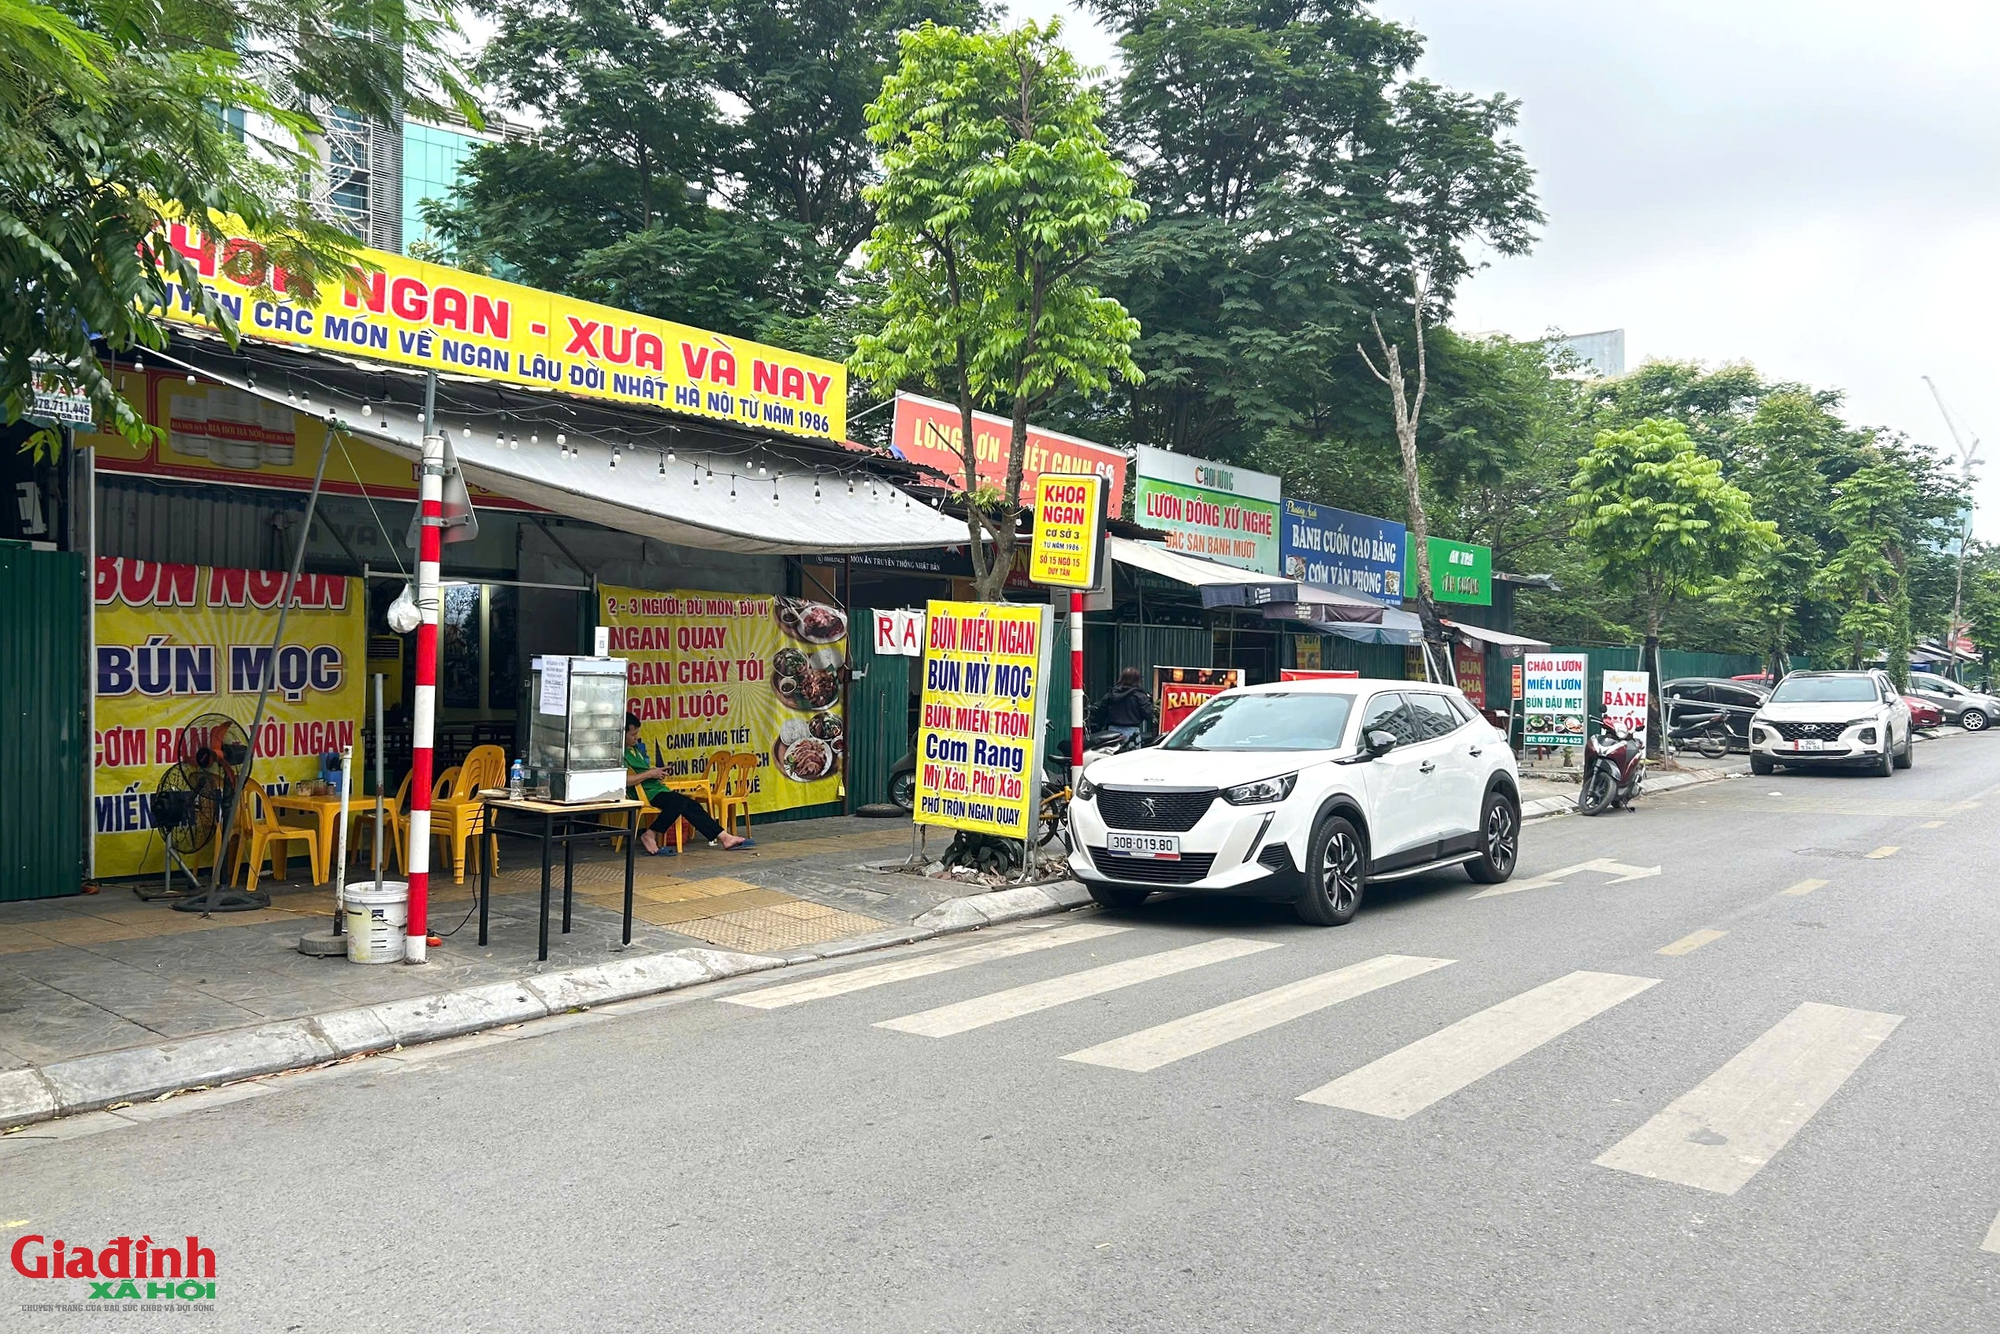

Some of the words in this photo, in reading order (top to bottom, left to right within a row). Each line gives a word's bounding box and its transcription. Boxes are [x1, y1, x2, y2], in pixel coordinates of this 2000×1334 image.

[344, 266, 509, 339] NGAN
[565, 317, 663, 371] XƯA
[681, 337, 735, 386] VÀ
[753, 360, 831, 405] NAY
[254, 299, 313, 335] CÁC
[324, 315, 388, 349] MÓN
[399, 328, 438, 358] VỀ
[442, 339, 509, 372] NGAN
[519, 354, 561, 382] LÂU
[569, 360, 605, 390] ĐỜI
[613, 373, 668, 401] NHẤT
[676, 381, 700, 408] HÀ
[708, 391, 734, 417] NỘI
[740, 394, 759, 419] TỪ
[763, 402, 794, 426] NĂM
[799, 411, 829, 433] 1986
[913, 416, 963, 452] LÒNG
[1044, 485, 1086, 504] KHOA
[1043, 506, 1085, 525] NGAN
[1147, 492, 1182, 520] LƯƠN
[1186, 494, 1220, 527] ĐỒNG
[1223, 504, 1241, 530] XỨ
[1243, 510, 1272, 540] NGHỆ
[1046, 529, 1058, 538] CƠ
[1060, 528, 1072, 539] SỞ
[1066, 543, 1080, 551] 1986
[1187, 528, 1205, 552] SẢN
[1207, 533, 1231, 556] BÁNH
[1323, 524, 1350, 555] CUỐN
[1352, 536, 1370, 560] CAO
[1372, 530, 1396, 563] BẰNG
[1049, 556, 1057, 565] 15
[1073, 559, 1080, 567] 15
[1352, 565, 1382, 594] PHÒNG
[607, 598, 617, 615] 2
[630, 598, 639, 615] 3
[609, 626, 670, 650] NGAN
[677, 626, 727, 652] QUAY
[930, 609, 958, 650] BÚN
[960, 608, 995, 652] MIẾN
[997, 620, 1036, 655] NGAN
[95, 634, 217, 697] BÚN
[227, 644, 345, 702] MỌC
[627, 661, 671, 686] GAN
[677, 656, 731, 684] CHÁY
[736, 652, 765, 682] TỎI
[927, 653, 961, 692] BÚN
[965, 656, 991, 695] MỲ
[994, 664, 1032, 704] MỌC
[1460, 659, 1481, 675] BÚN
[1527, 659, 1553, 672] CHÁO
[1556, 660, 1582, 672] LƯƠN
[1460, 677, 1482, 693] CHẢ
[1527, 675, 1553, 690] MIẾN
[1556, 678, 1582, 690] LƯƠN
[627, 697, 671, 721] GAN
[678, 690, 729, 722] LUỘC
[1526, 695, 1543, 708] BÚN
[1545, 695, 1562, 711] ĐẬU
[1565, 697, 1582, 711] MẸT
[1604, 687, 1646, 707] BÁNH
[924, 700, 952, 730] BÚN
[955, 701, 991, 733] MIẾN
[994, 708, 1030, 741] TRỘN
[293, 720, 354, 756] NGAN
[666, 731, 695, 750] CANH
[698, 728, 728, 748] MĂNG
[730, 724, 751, 745] TIẾT
[926, 733, 968, 763] Cơm
[974, 738, 1024, 773] Rang
[923, 764, 941, 791] Mỳ
[943, 766, 969, 795] Xào,
[972, 769, 996, 795] Phở
[998, 773, 1021, 799] Xào
[921, 793, 940, 814] PHỞ
[942, 797, 966, 820] TRỘN
[968, 802, 994, 822] NGAN
[996, 806, 1020, 826] QUAY
[1113, 836, 1173, 851] 30B-019.80
